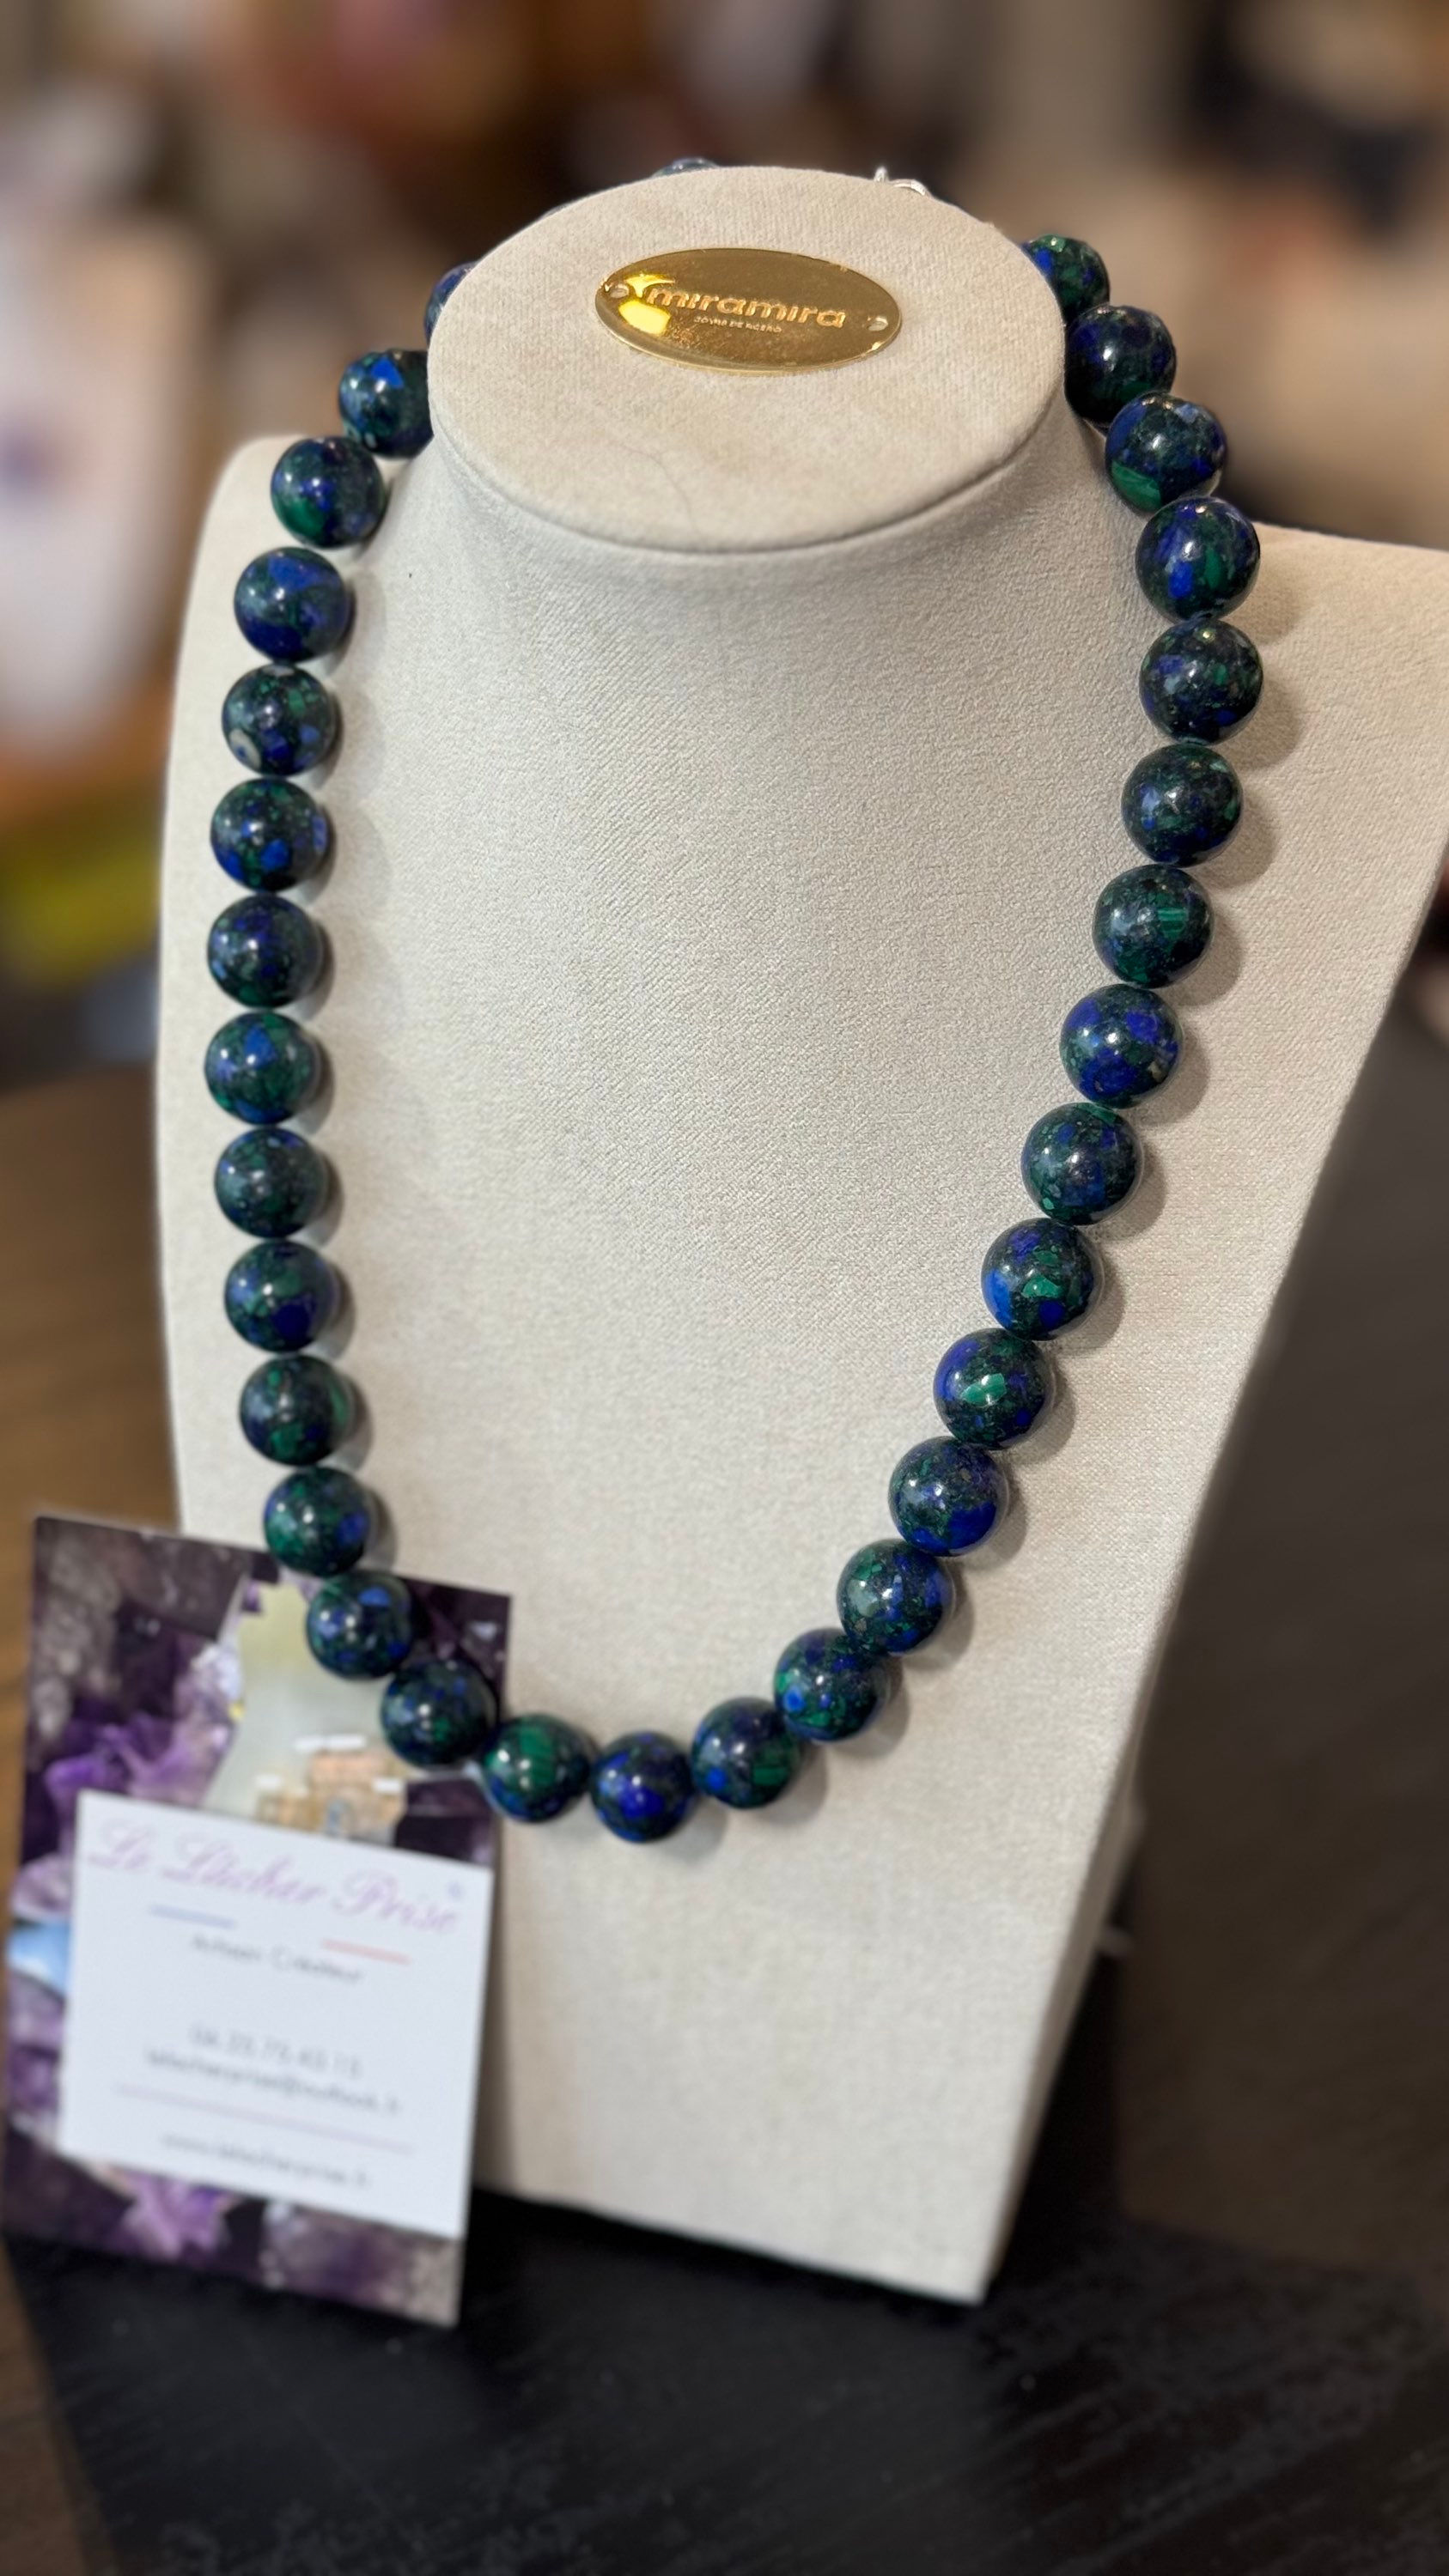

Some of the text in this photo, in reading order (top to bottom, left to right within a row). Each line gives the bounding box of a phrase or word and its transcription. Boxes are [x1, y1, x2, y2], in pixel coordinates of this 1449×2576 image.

[646, 287, 846, 329] miramira
[88, 1820, 155, 1870] Le
[332, 1870, 460, 1931] Prise
